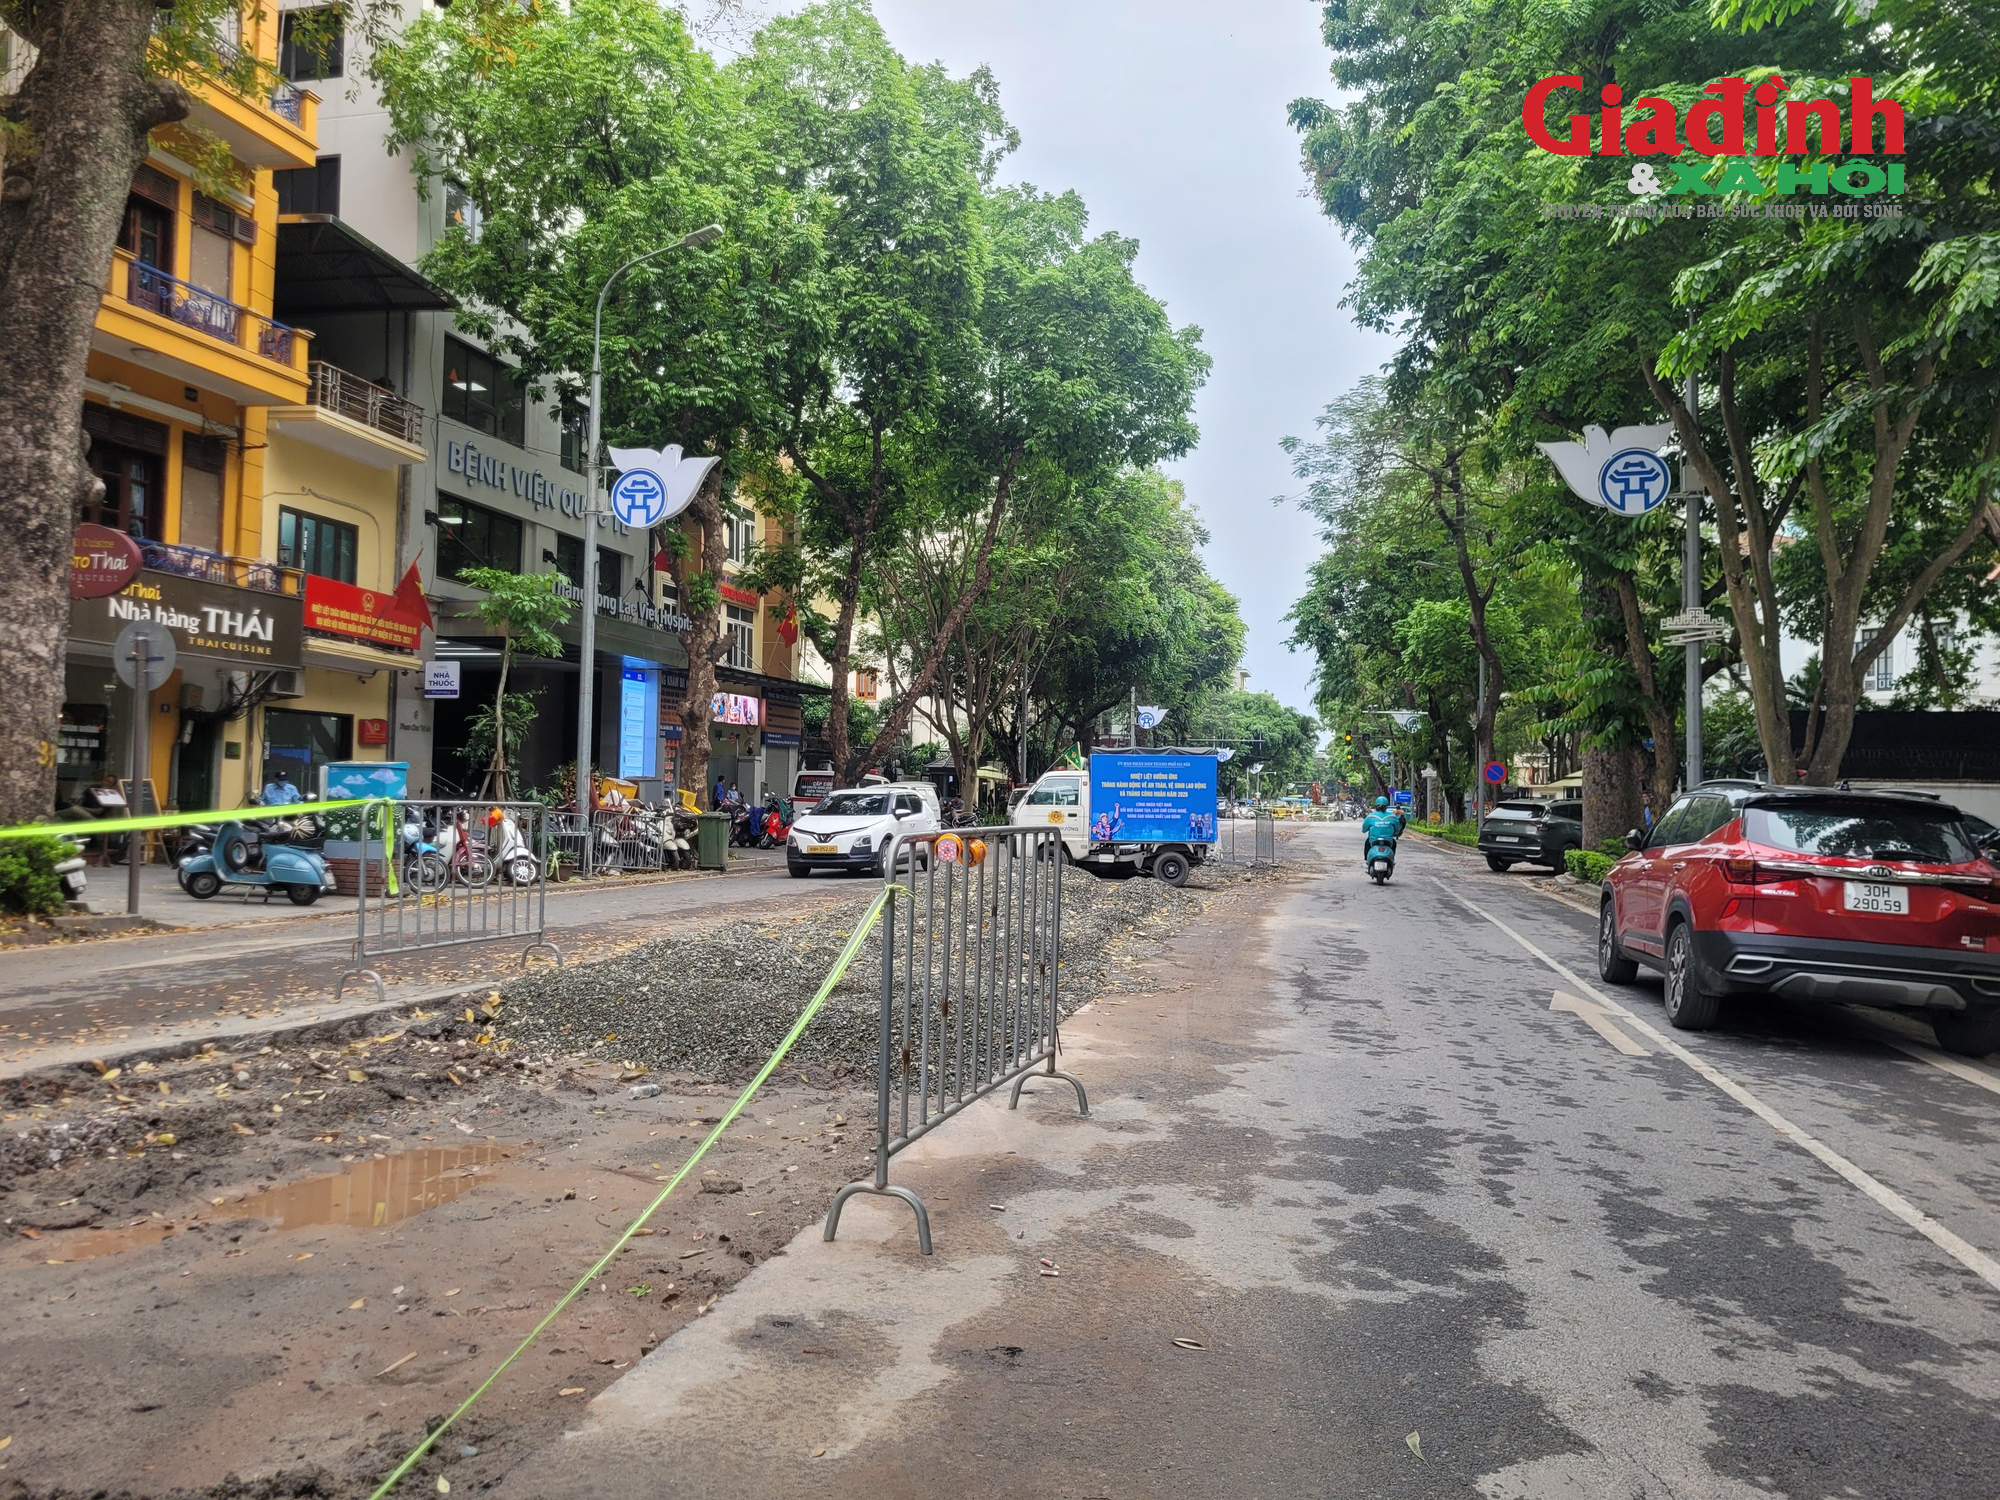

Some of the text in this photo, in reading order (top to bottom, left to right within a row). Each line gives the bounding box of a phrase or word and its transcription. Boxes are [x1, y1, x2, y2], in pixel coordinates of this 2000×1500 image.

[449, 441, 507, 490] BỆNH
[512, 470, 556, 511] VIỆN
[108, 598, 274, 641] Nhà hàng THÁI
[189, 637, 272, 655] THAI CUISINE
[1871, 868, 1890, 876] KIA
[1863, 885, 1890, 898] 30H
[1853, 898, 1902, 912] 290.59
